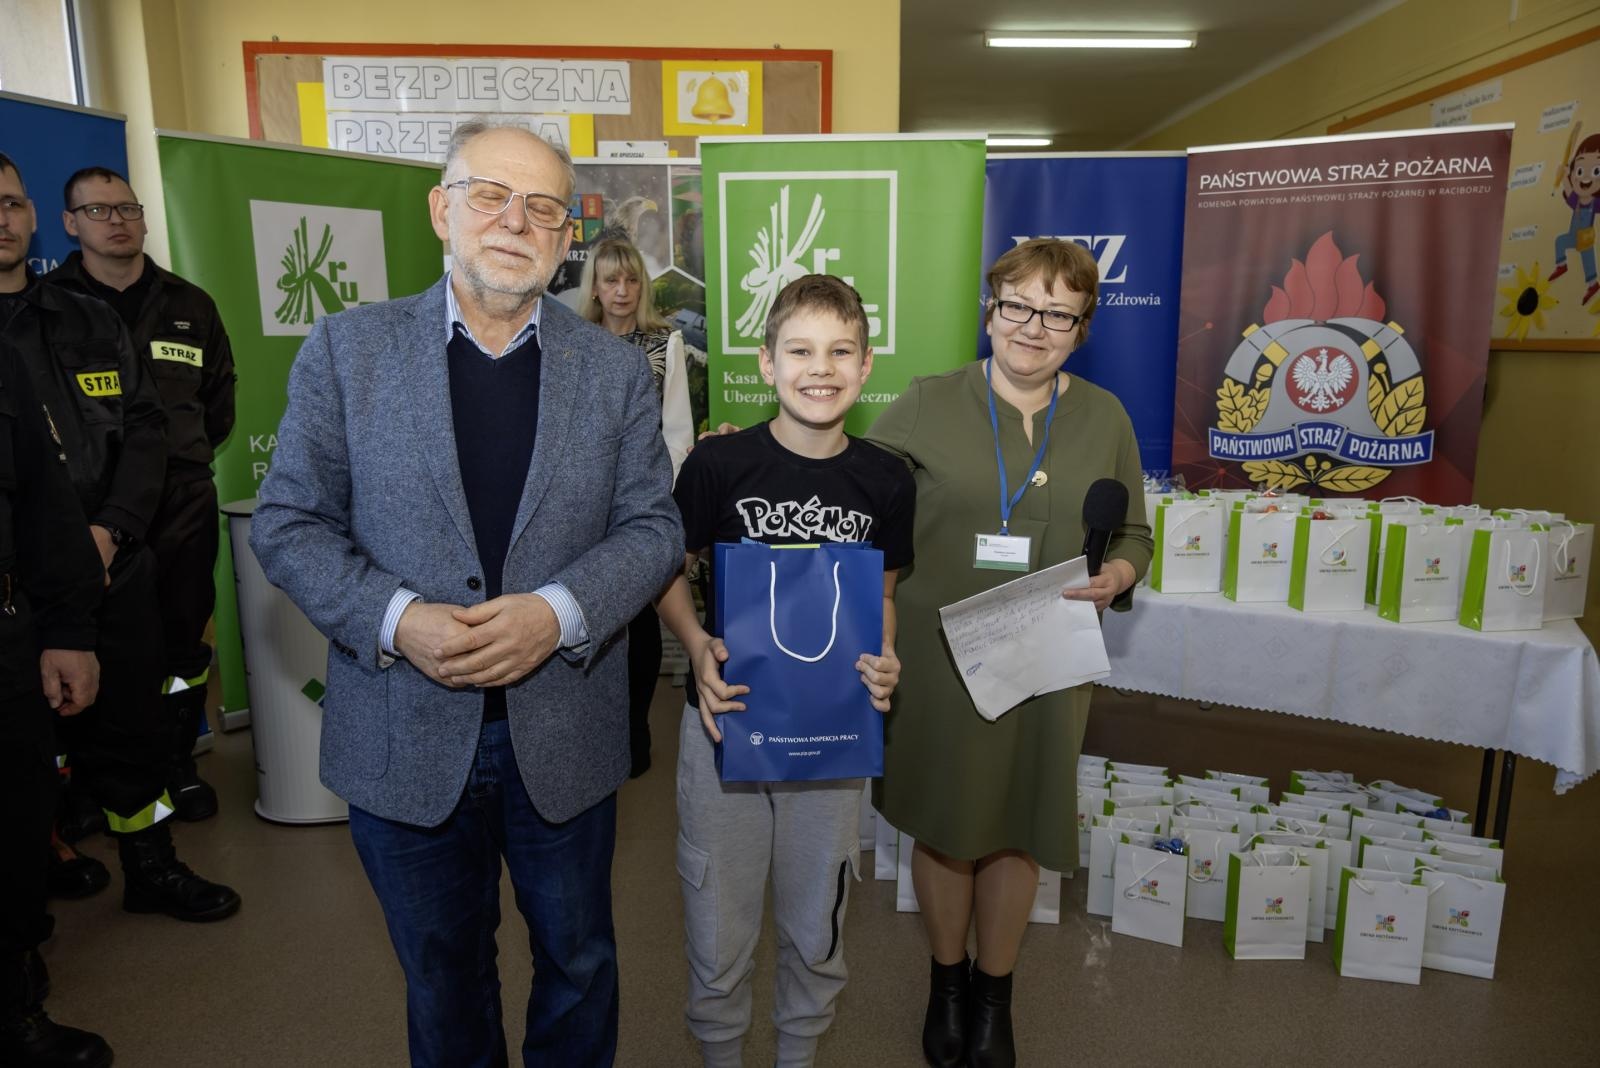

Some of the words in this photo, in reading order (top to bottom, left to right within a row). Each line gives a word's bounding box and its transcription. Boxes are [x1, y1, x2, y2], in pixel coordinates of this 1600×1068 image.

[332, 65, 630, 103] BEZPIECZNA
[334, 120, 567, 154] PRZEA
[1199, 169, 1323, 190] PAŃSTWOWA
[1327, 158, 1390, 182] STRAŻ
[1394, 155, 1493, 178] POŻARNA
[1198, 200, 1238, 209] KOMENDA
[1238, 197, 1288, 207] POWIATOWA
[1106, 293, 1161, 306] Zdrowia
[83, 375, 120, 392] STRA
[723, 371, 759, 385] Kasa
[723, 389, 780, 407] Ubezpi
[1299, 427, 1342, 448] STRAŻ
[1213, 434, 1294, 456] PAŃSTWOWA
[1348, 438, 1425, 461] POŻARNA
[768, 734, 809, 744] PAŃSTWOWA
[809, 734, 839, 743] INSPEKCJA
[839, 733, 860, 741] PRACY
